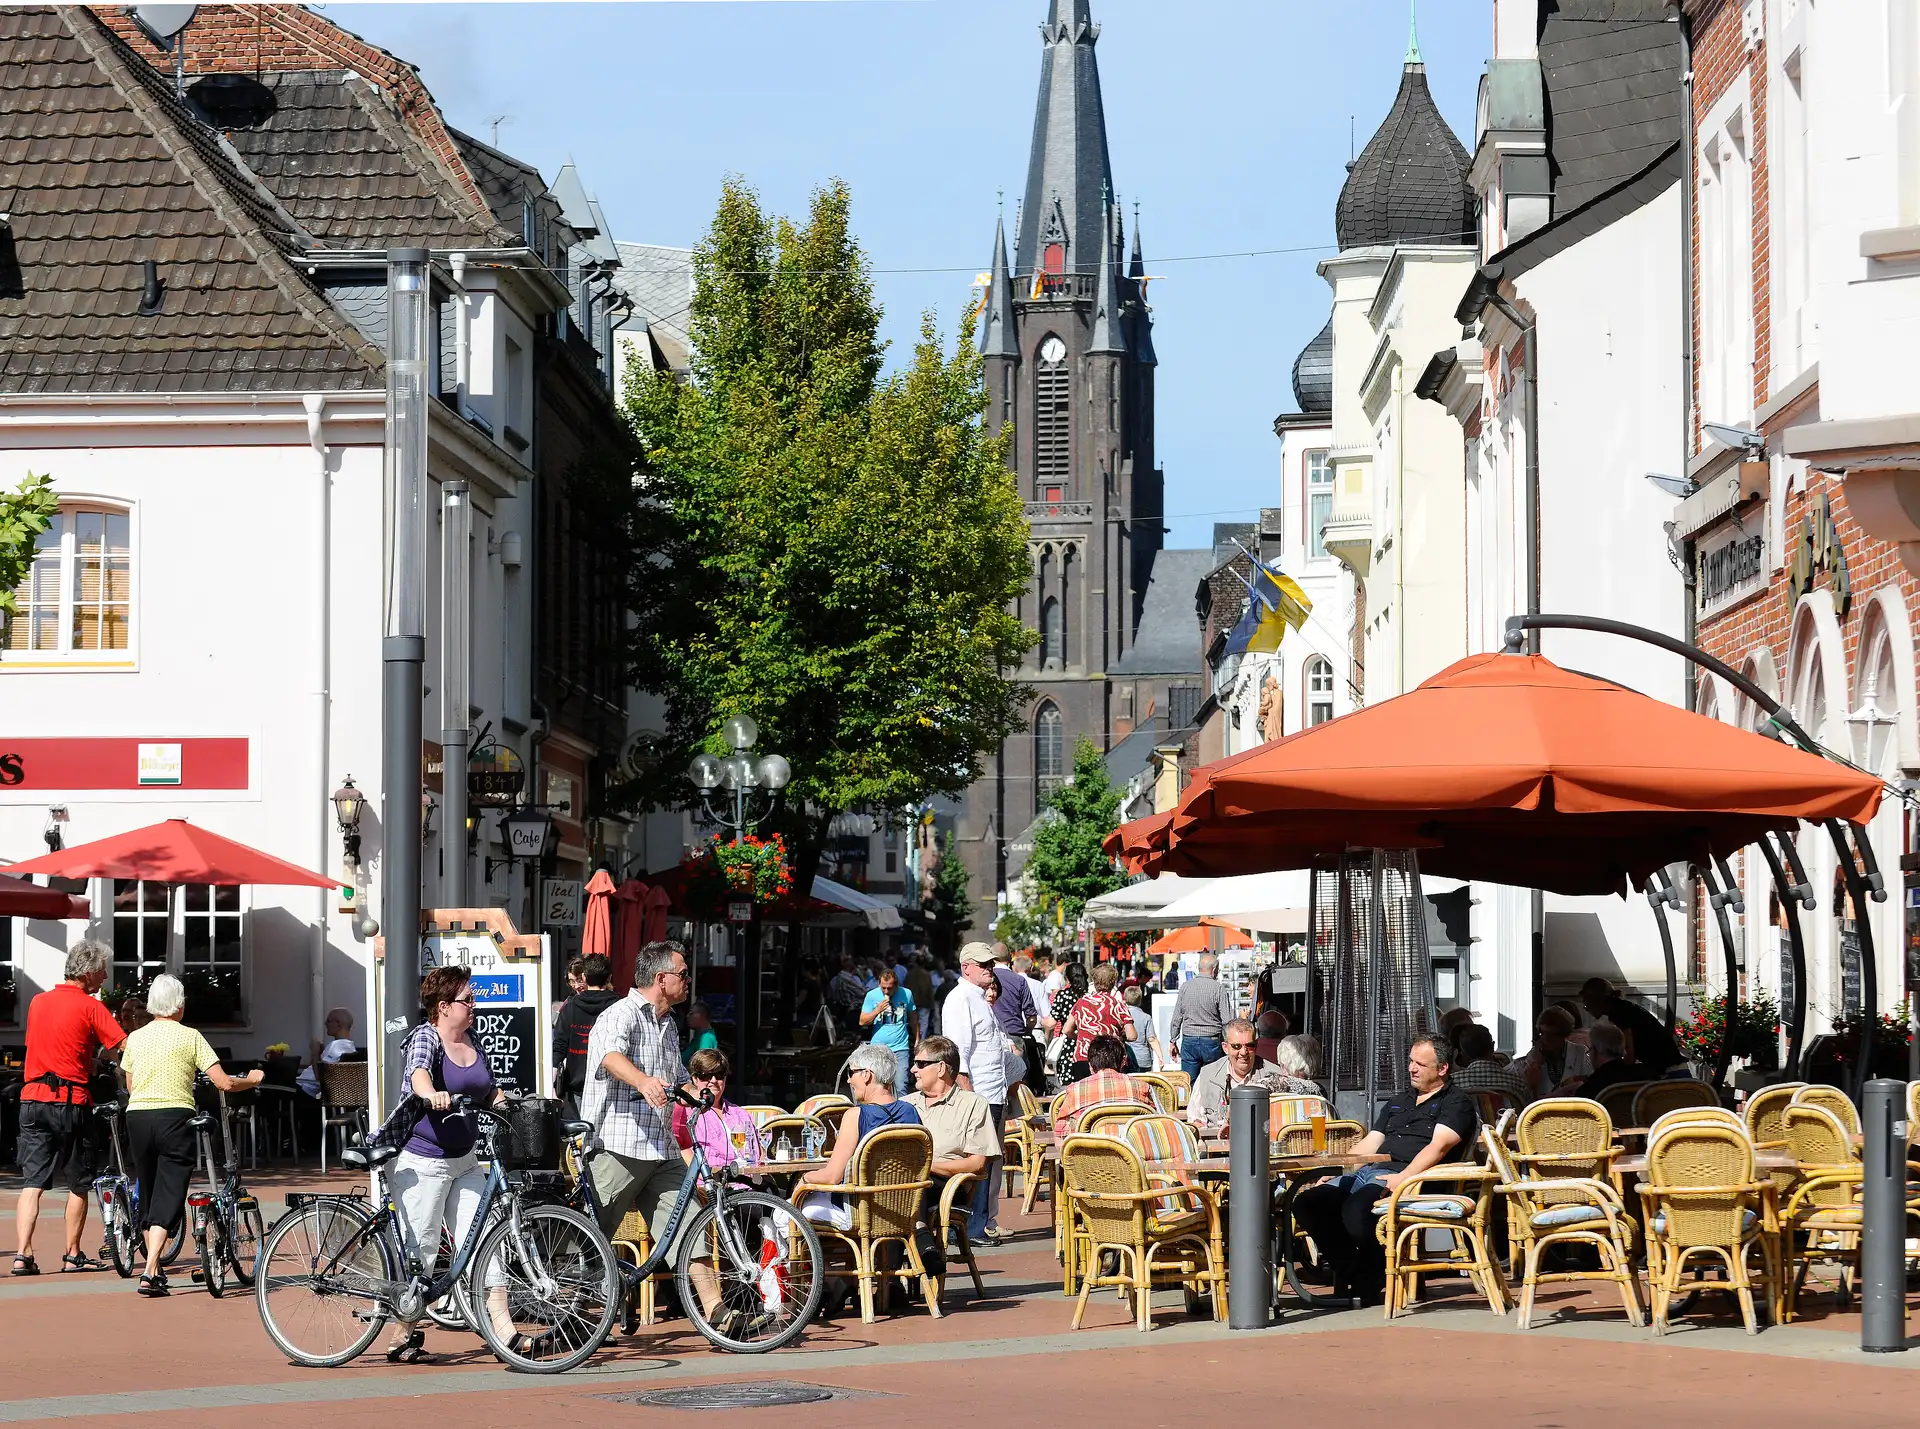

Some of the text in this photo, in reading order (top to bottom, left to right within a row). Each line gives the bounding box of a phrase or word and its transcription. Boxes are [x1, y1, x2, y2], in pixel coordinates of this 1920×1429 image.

[473, 775, 516, 790] 1841
[512, 828, 540, 848] Cafe
[550, 882, 576, 898] Ital.
[549, 902, 575, 920] Eis
[490, 982, 509, 997] Alt
[476, 1014, 514, 1034] DRY
[480, 1035, 521, 1054] GED
[488, 1055, 519, 1074] EF
[664, 1198, 685, 1239] KETTLER
[463, 1210, 482, 1251] KETTLER
